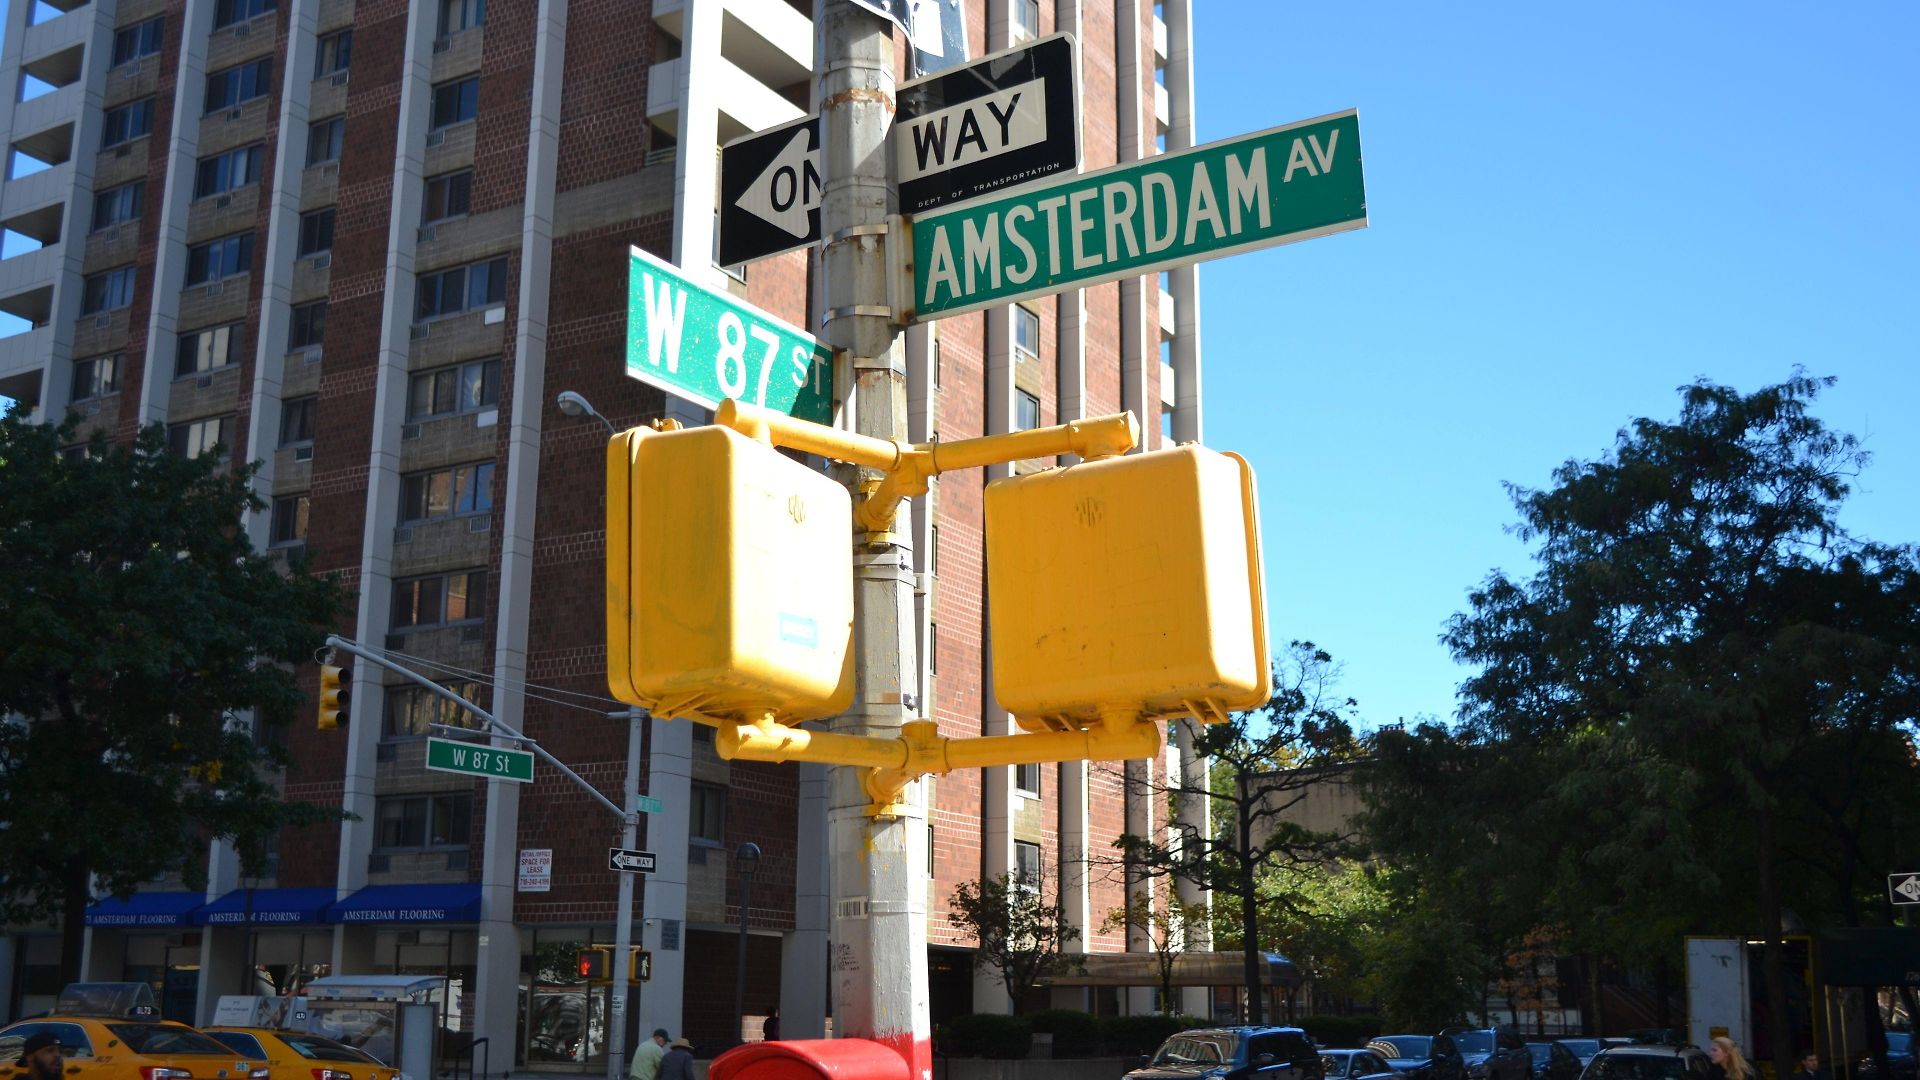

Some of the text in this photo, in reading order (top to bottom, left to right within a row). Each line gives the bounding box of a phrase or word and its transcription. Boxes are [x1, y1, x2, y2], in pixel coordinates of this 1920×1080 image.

[770, 93, 1022, 212] ON WAY
[918, 162, 1060, 208] DEPT OF TRANSPORTATION
[924, 129, 1340, 305] AMSTERDAM AV
[642, 271, 826, 408] W 87 ST
[453, 748, 510, 773] W 87 St
[521, 857, 550, 866] SPACE FOR
[617, 855, 651, 867] ONE WAY
[94, 914, 136, 924] AMSTERDAM
[139, 914, 177, 924] FLOORING
[209, 912, 300, 922] AMSTERDM FLOORING
[343, 909, 444, 920] AMSTERDAM FLOORING
